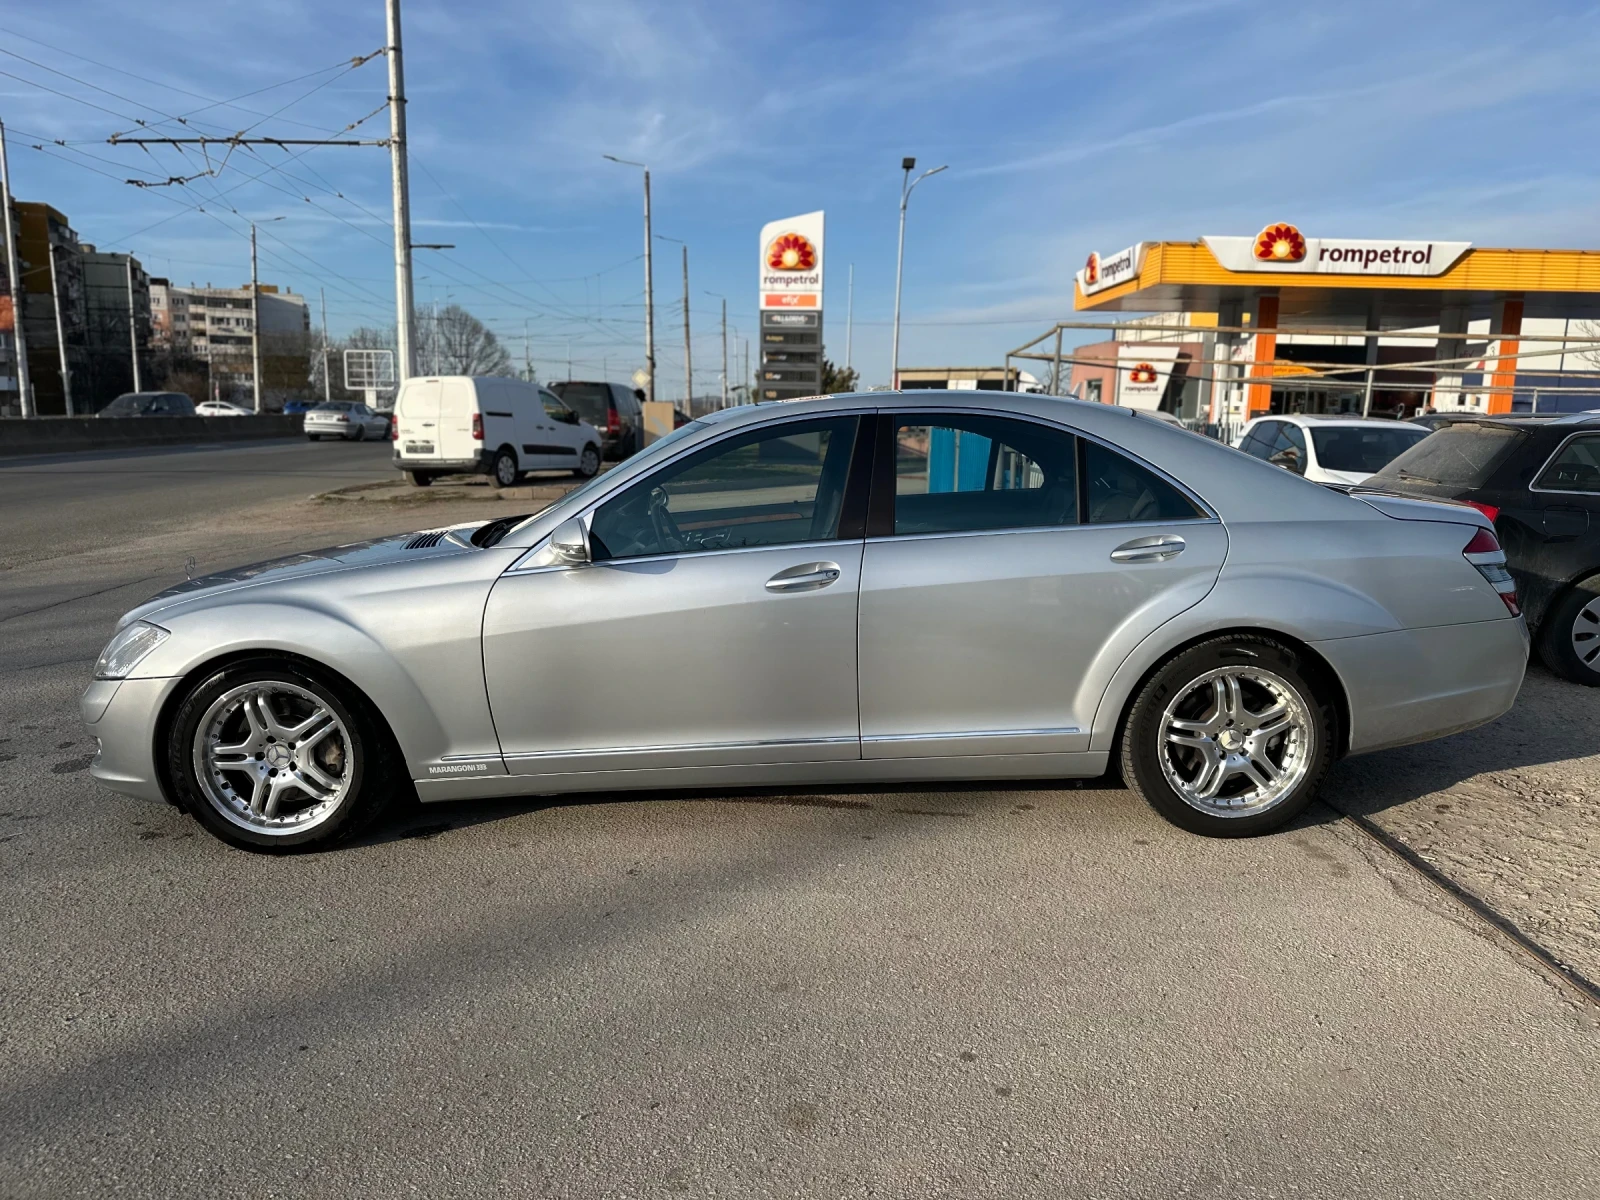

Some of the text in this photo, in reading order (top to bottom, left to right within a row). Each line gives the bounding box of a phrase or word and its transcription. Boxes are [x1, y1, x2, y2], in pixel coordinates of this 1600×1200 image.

[1319, 244, 1433, 269] rompetrol
[1101, 249, 1131, 280] rompetrol
[764, 273, 819, 287] rompetrol
[1125, 385, 1158, 393] rompetrol
[428, 765, 476, 774] MARANGONI
